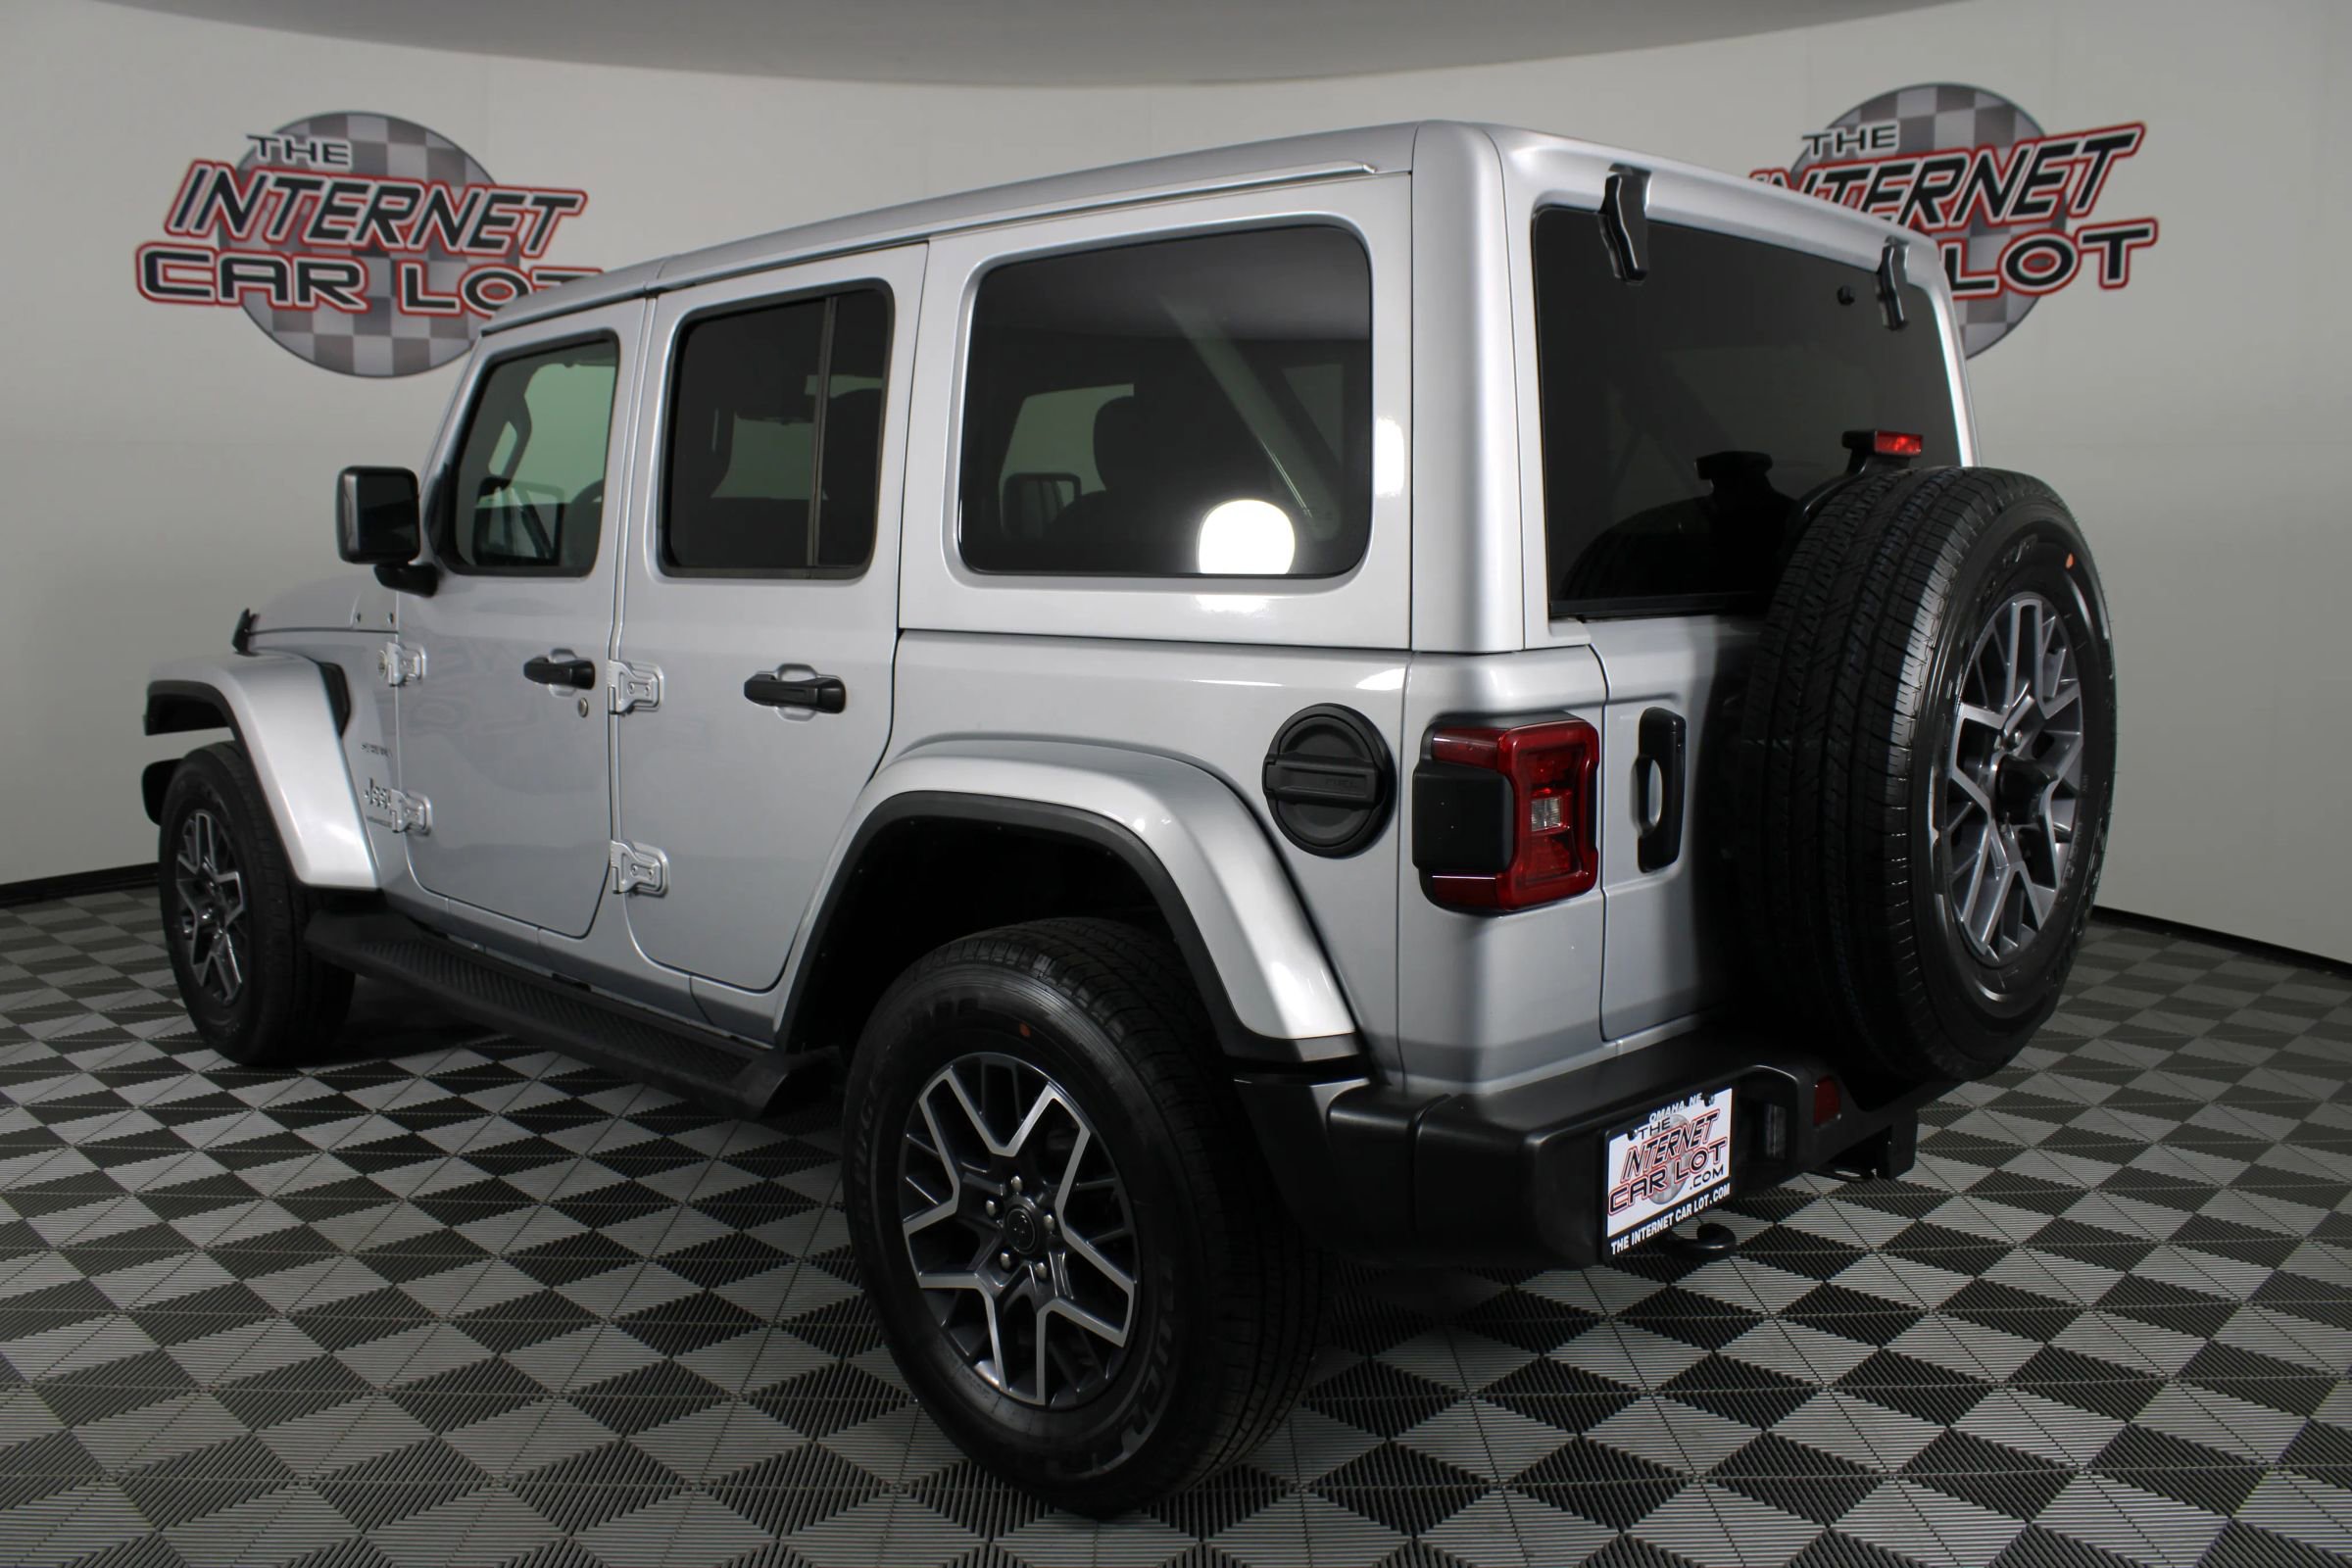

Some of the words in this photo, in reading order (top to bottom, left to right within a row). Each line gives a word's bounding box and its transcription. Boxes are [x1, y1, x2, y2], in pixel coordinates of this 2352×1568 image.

[246, 133, 352, 167] THE
[1748, 121, 2146, 230] TERNET
[1802, 120, 1900, 158] THE
[165, 159, 588, 258] INTERNET
[135, 240, 371, 314] CAR
[398, 260, 604, 318] LO
[1940, 218, 2159, 301] LOT
[1620, 1108, 1720, 1182] INTERNET
[1638, 1117, 1670, 1140] THE
[1608, 1167, 1667, 1215] CAR
[1674, 1137, 1728, 1184] LOT
[1690, 1164, 1724, 1190] .COM
[1611, 1235, 1630, 1254] THE
[1631, 1212, 1674, 1246] INTERNET
[1675, 1203, 1692, 1222] CAR
